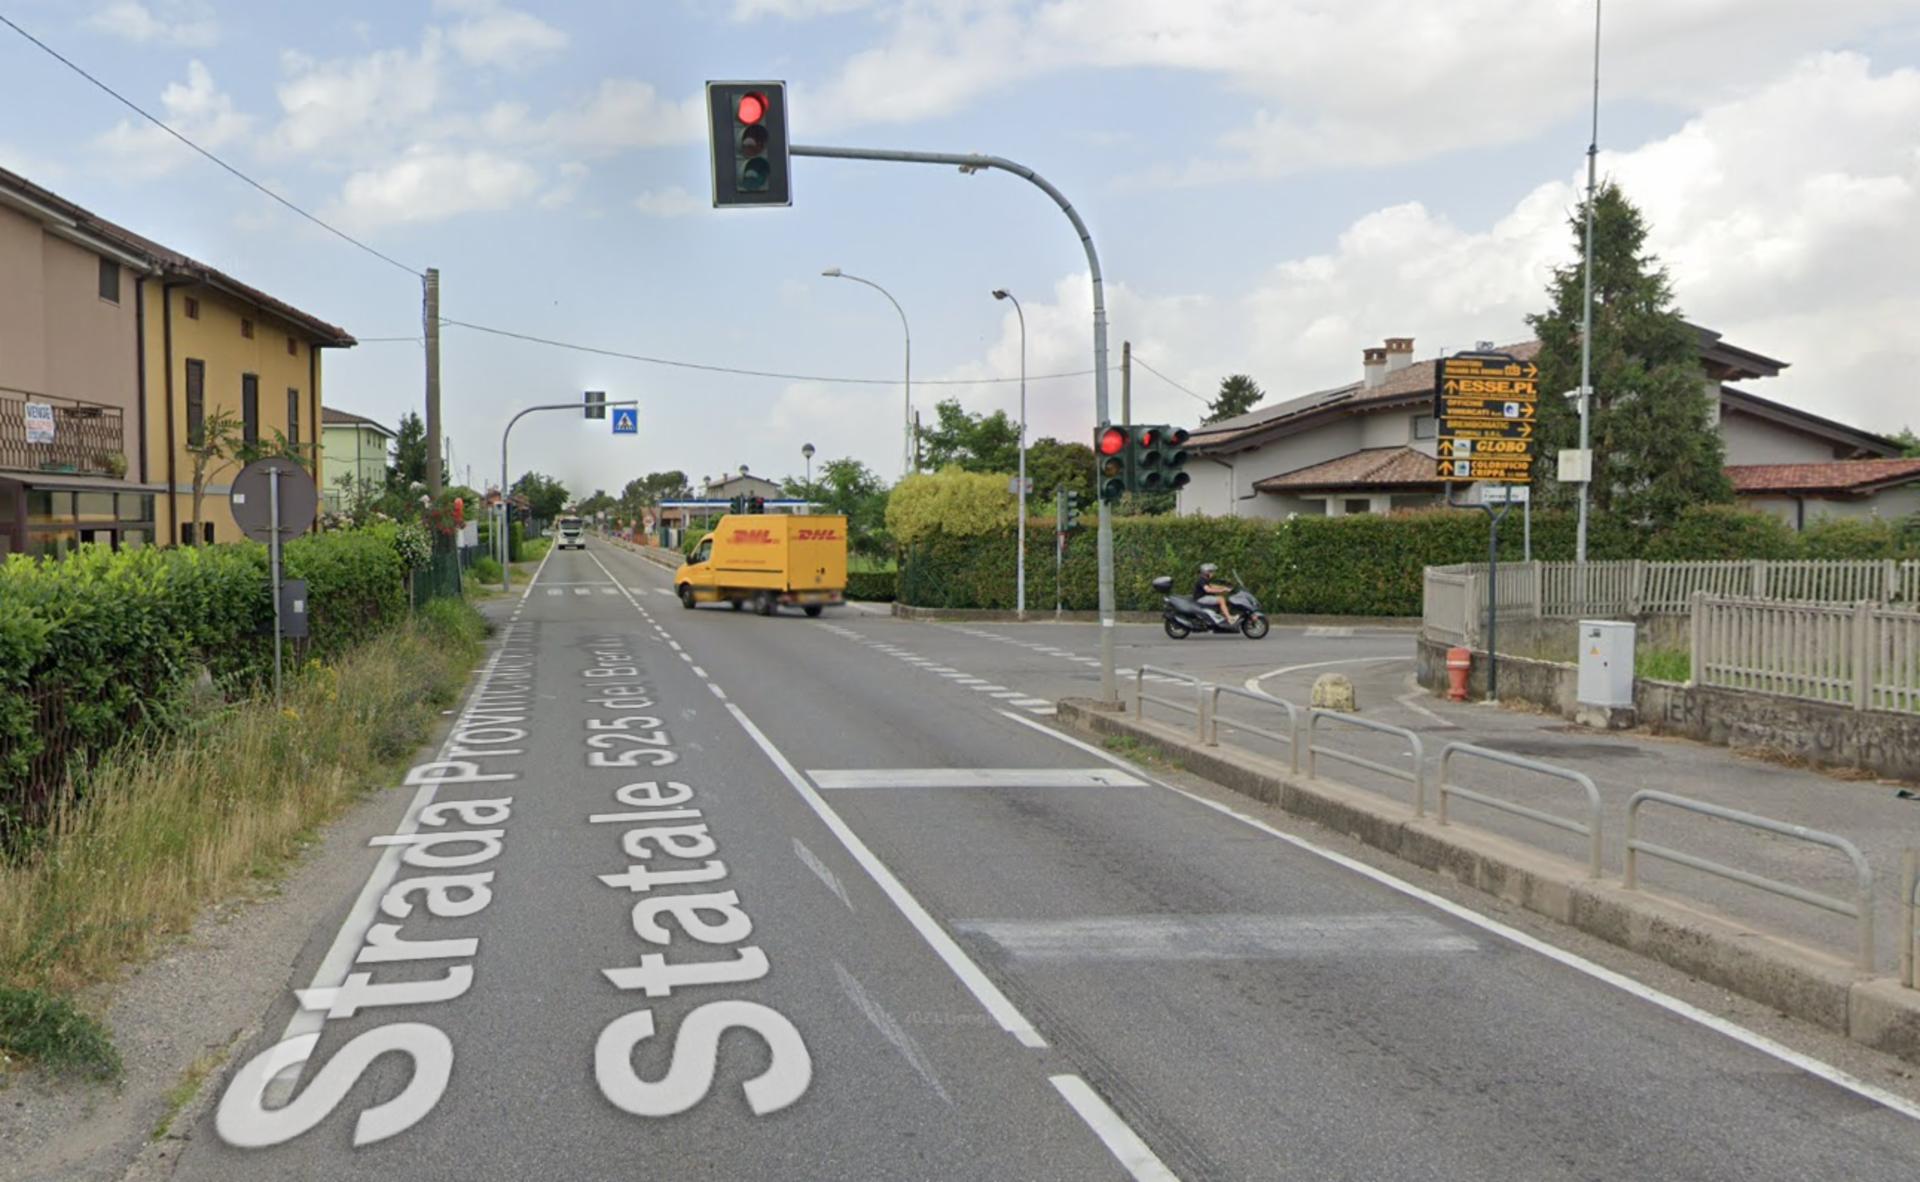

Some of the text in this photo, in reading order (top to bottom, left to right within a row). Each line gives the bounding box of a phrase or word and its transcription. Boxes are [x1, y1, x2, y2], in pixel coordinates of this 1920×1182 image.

[1476, 440, 1527, 453] GLOBO
[1471, 460, 1529, 470] COLORIFICIO
[1471, 469, 1505, 477] CRIPPA
[733, 529, 772, 544] DHL
[798, 529, 836, 541] DHL
